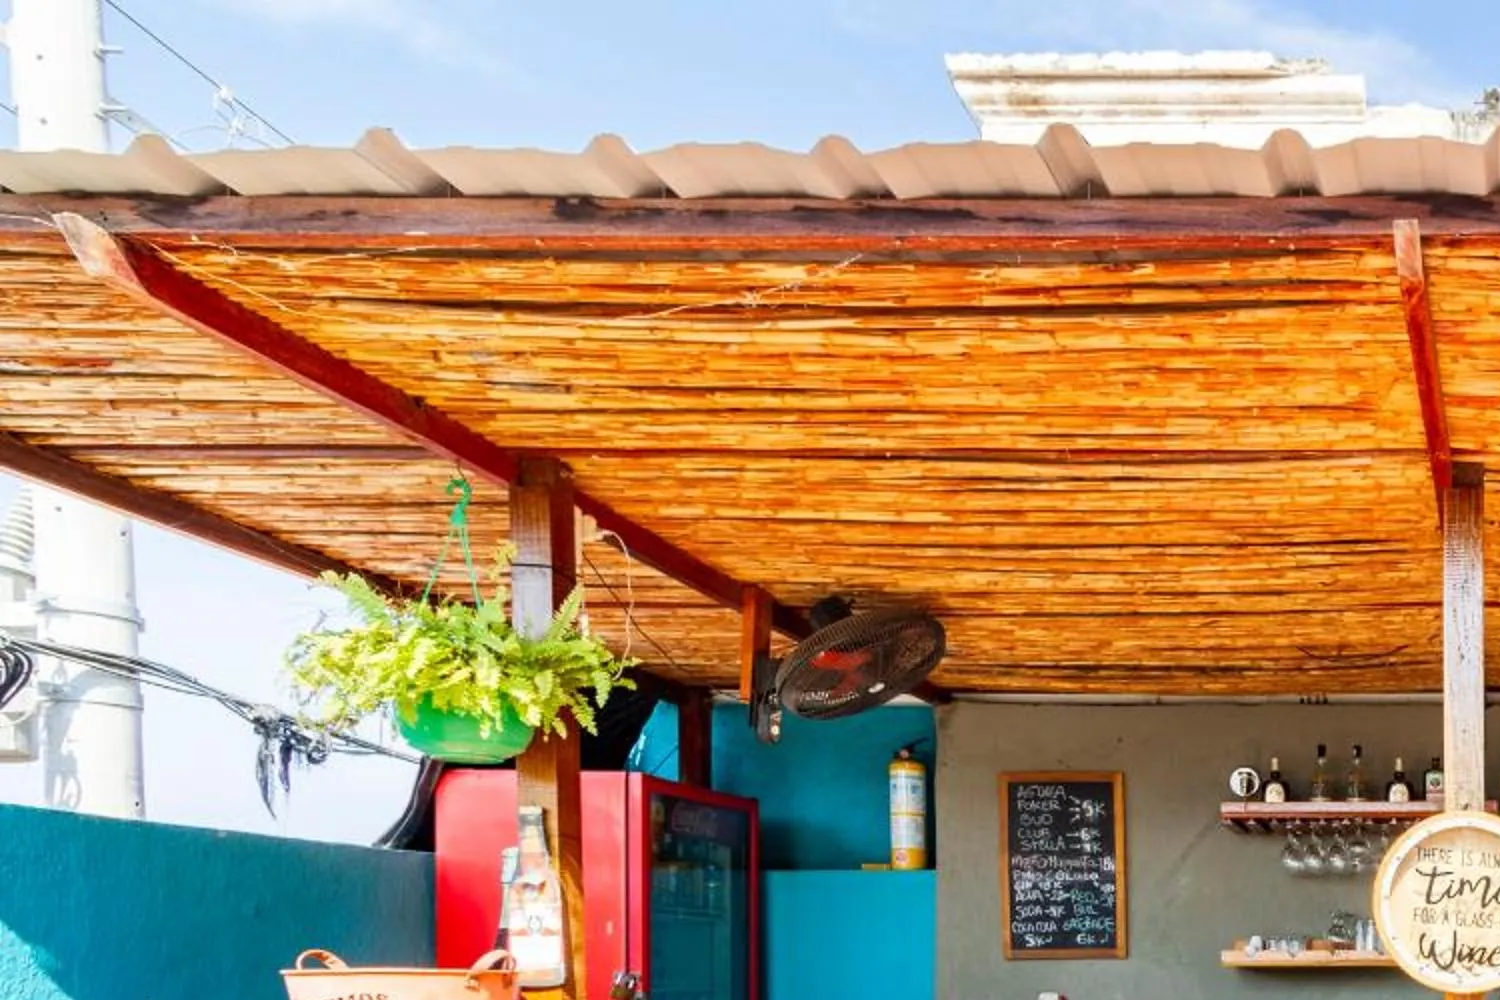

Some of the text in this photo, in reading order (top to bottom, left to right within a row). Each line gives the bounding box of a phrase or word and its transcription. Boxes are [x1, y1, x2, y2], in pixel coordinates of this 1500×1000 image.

[1417, 847, 1453, 864] THERE
[1461, 850, 1473, 867] IS
[1413, 907, 1437, 924] FOR
[1441, 908, 1450, 925] A
[1455, 911, 1494, 929] GLASS
